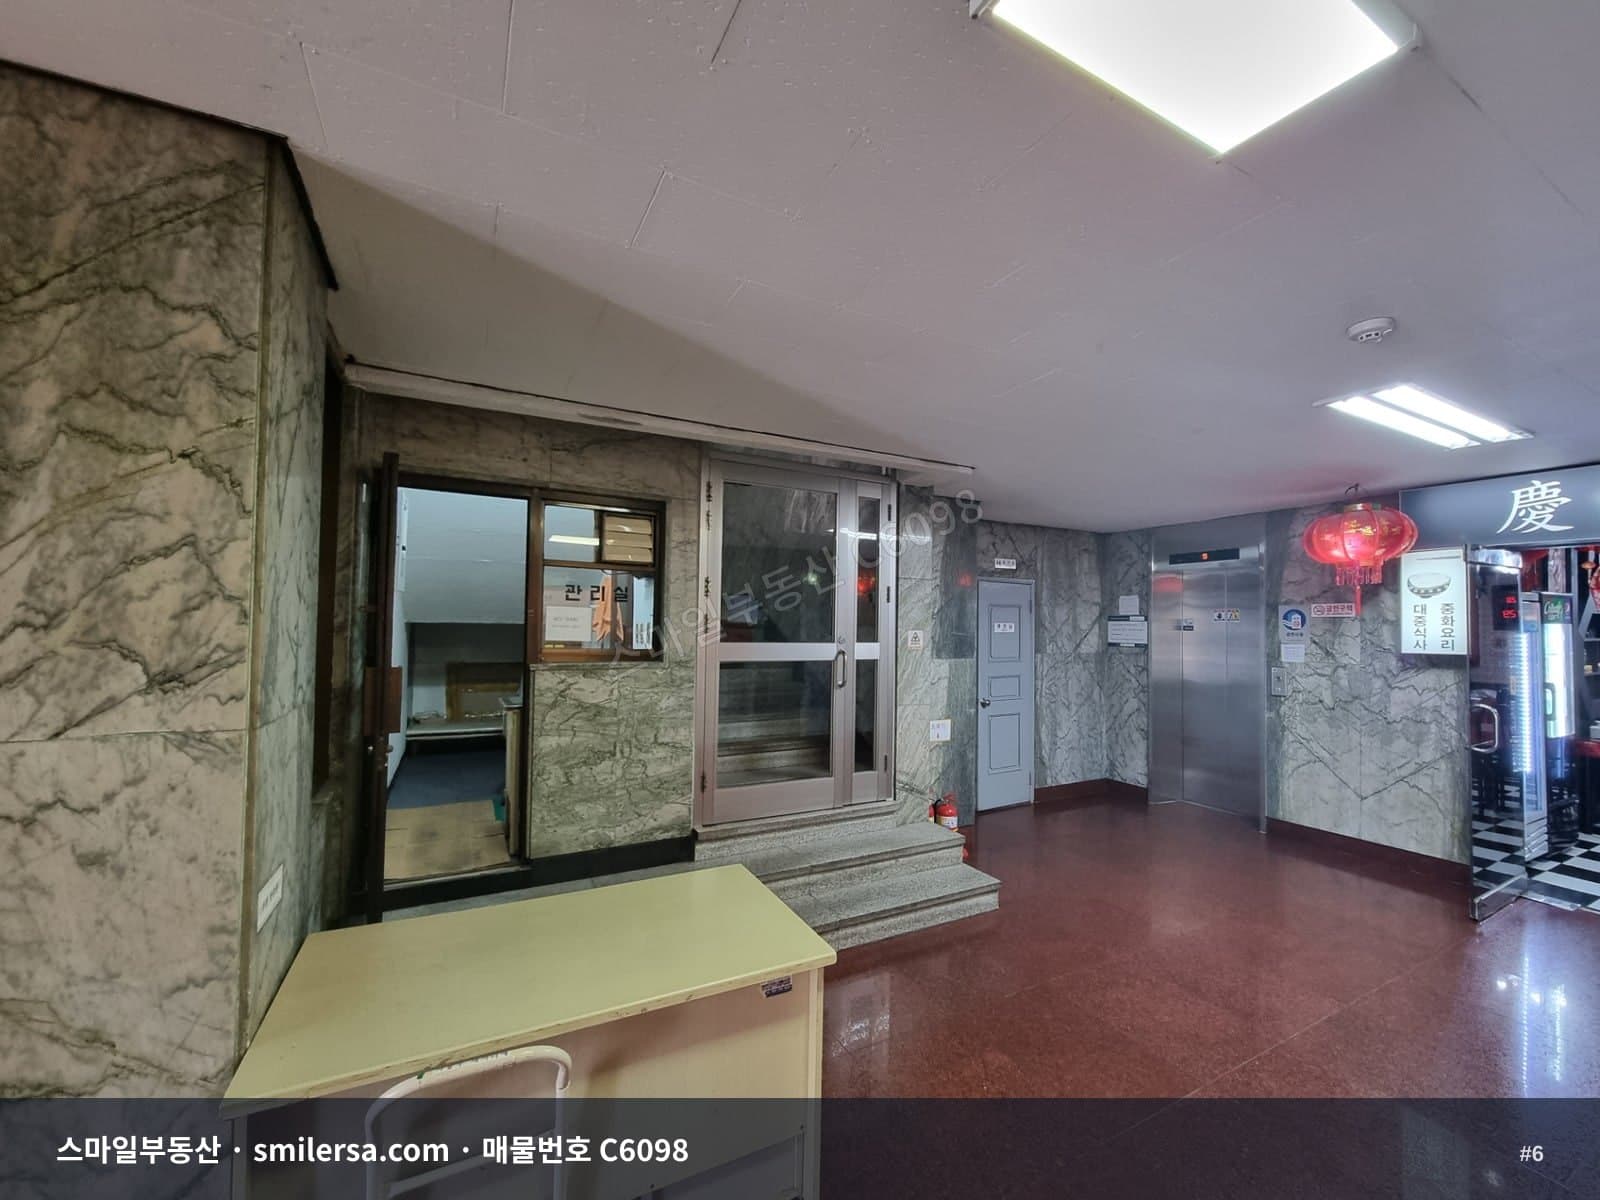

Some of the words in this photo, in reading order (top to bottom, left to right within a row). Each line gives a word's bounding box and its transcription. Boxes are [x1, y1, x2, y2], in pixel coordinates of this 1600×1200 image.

[1496, 480, 1575, 534] 慶
[1413, 603, 1427, 651] 대중식사
[1440, 602, 1456, 651] 중화요리
